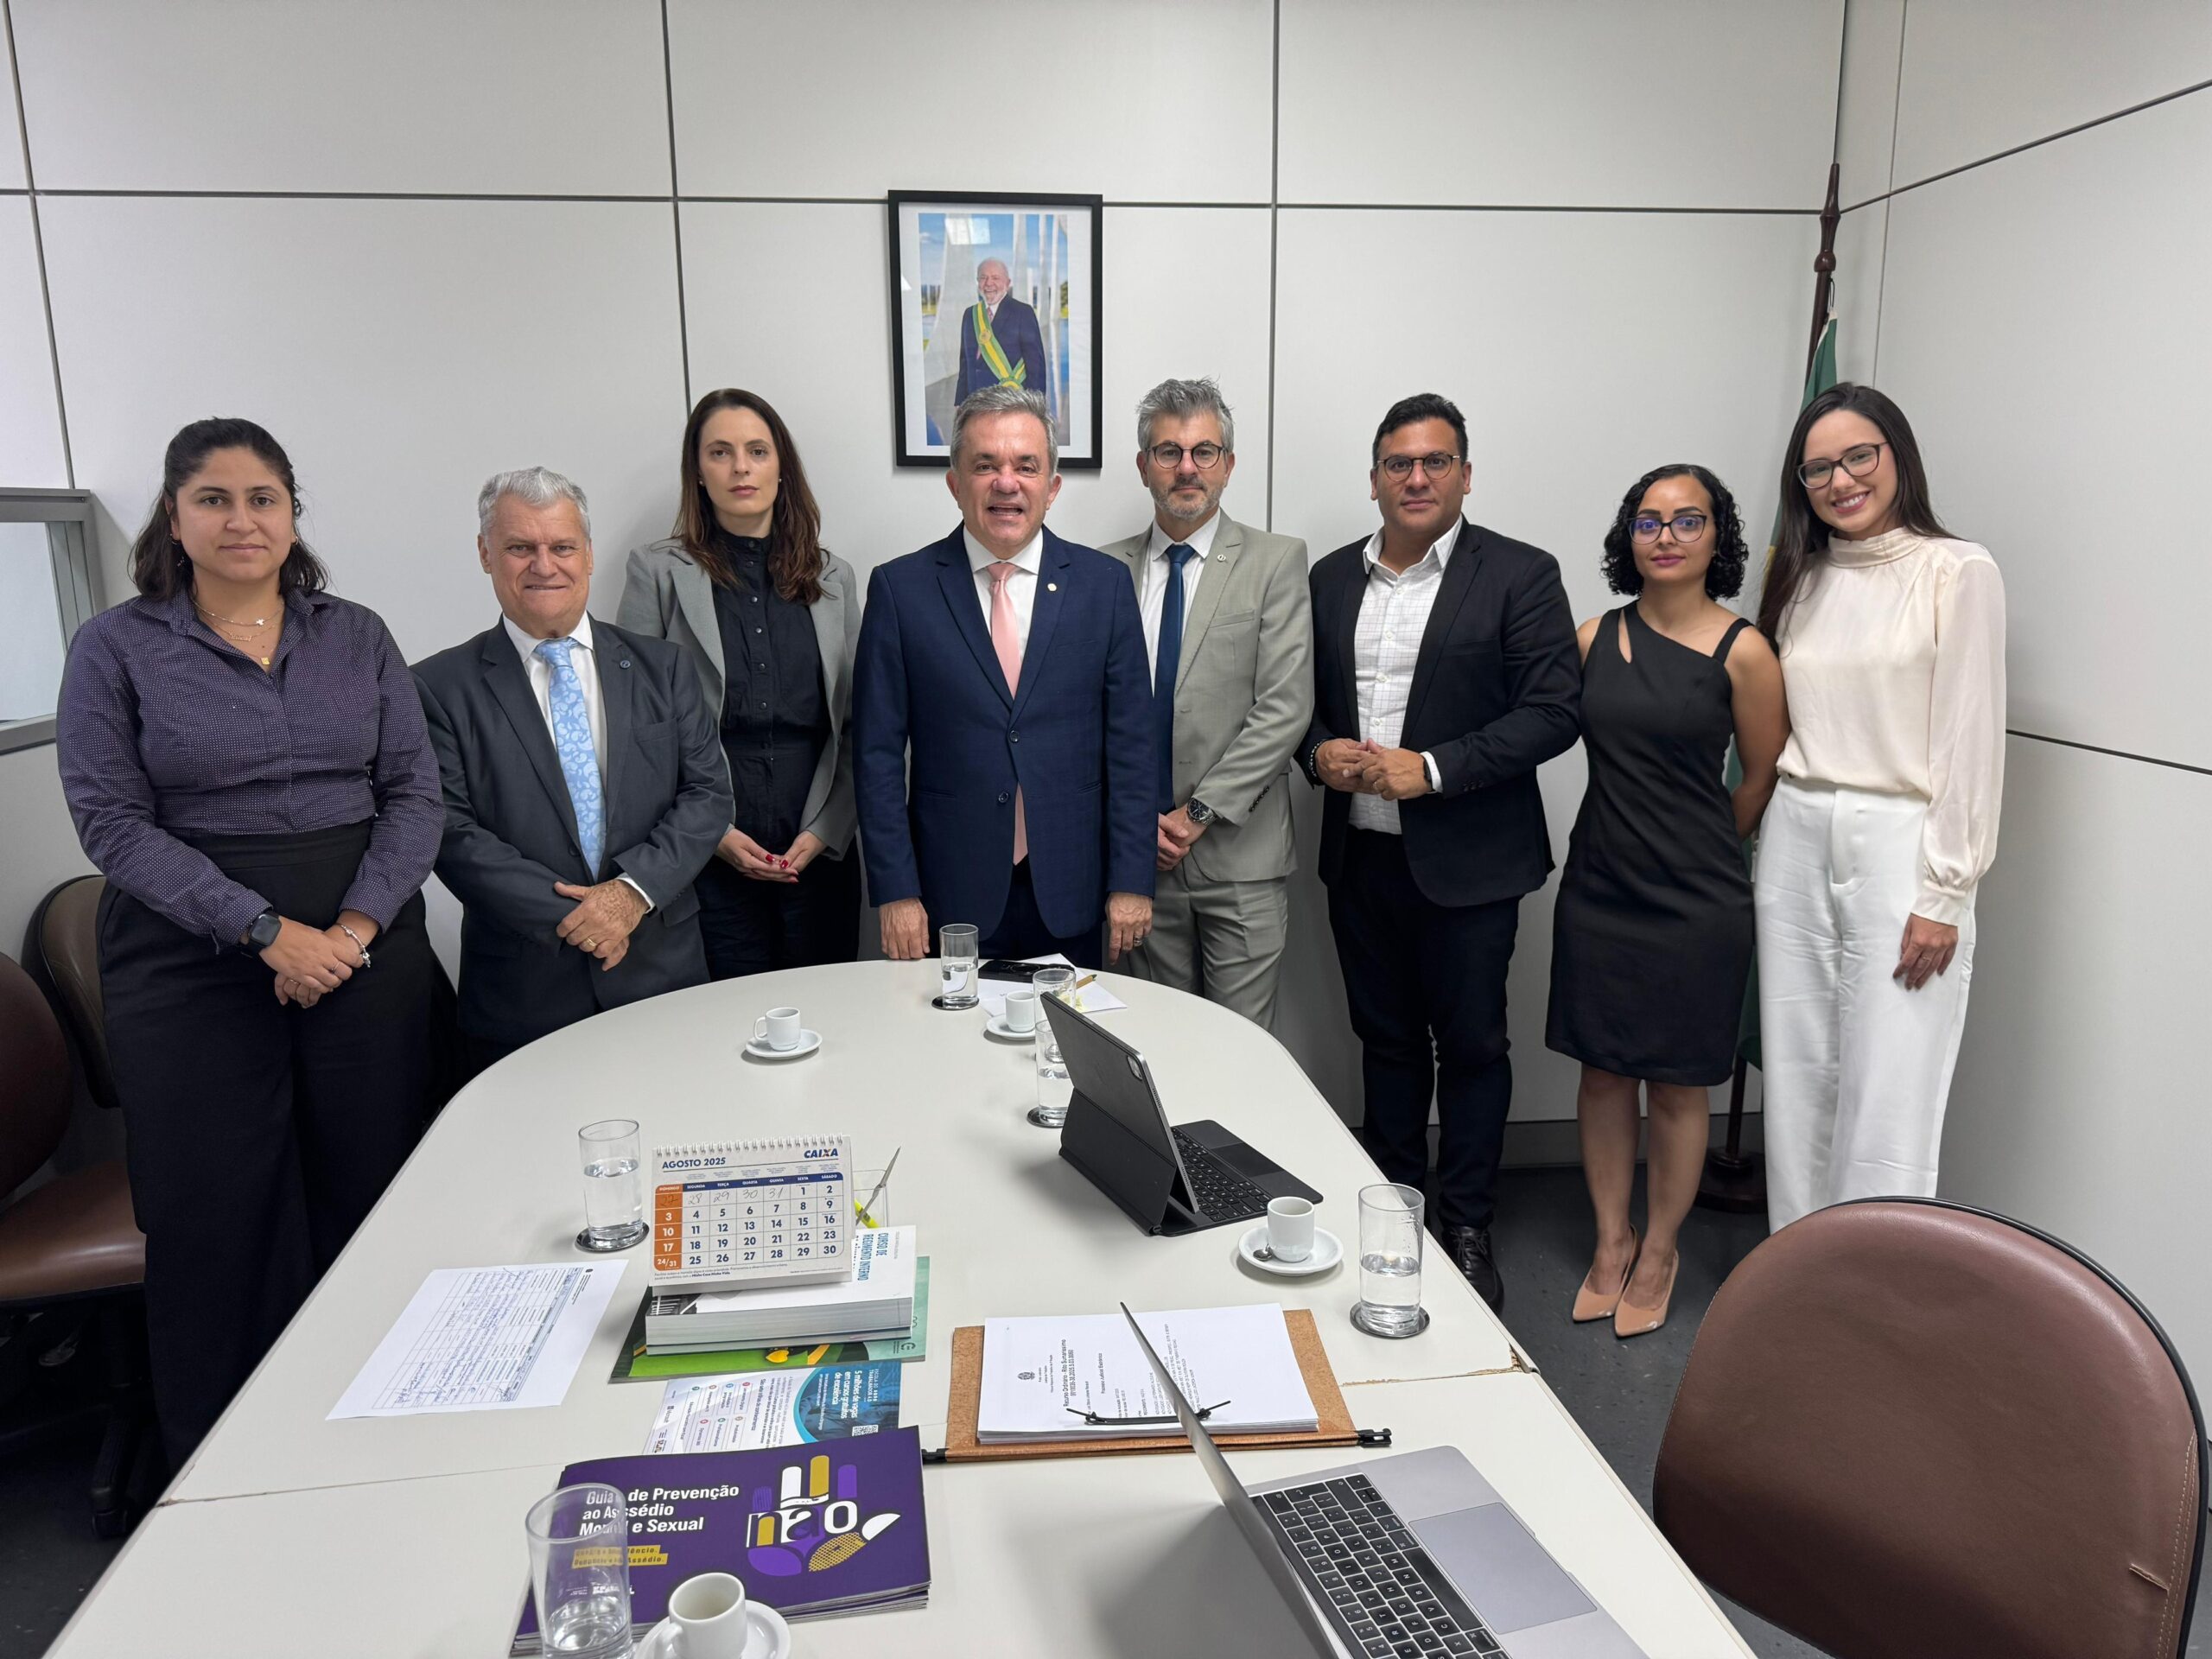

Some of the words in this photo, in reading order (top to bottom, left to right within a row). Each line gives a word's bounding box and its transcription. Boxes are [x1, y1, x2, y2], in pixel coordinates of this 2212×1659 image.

[804, 1148, 838, 1158] CAIXA
[662, 1159, 701, 1169] AGOSTO
[703, 1157, 726, 1166] 2025
[689, 1192, 702, 1205] 28
[713, 1191, 729, 1203] 29
[742, 1189, 758, 1198] 30
[769, 1186, 784, 1198] 31
[665, 1212, 672, 1221] 3
[662, 1228, 674, 1236] 10
[691, 1225, 700, 1234] 11
[717, 1224, 728, 1232] 12
[772, 1219, 782, 1228] 14
[663, 1243, 674, 1252] 17
[690, 1241, 701, 1249] 18
[772, 1235, 782, 1243] 21
[823, 1230, 836, 1239] 23
[861, 1234, 874, 1260] REGIMENTO
[877, 1233, 888, 1249] CURSO
[716, 1254, 729, 1262] 26
[771, 1249, 783, 1258] 28
[823, 1245, 836, 1254] 30
[857, 1261, 871, 1281] INTERNO
[844, 1371, 851, 1380] em
[832, 1379, 841, 1405] excelência
[853, 1375, 862, 1395] milhões
[841, 1396, 850, 1419] gratuitos
[849, 1402, 858, 1418] vagas
[586, 1491, 613, 1505] Guia
[628, 1489, 648, 1502] de
[652, 1484, 740, 1501] Prevenção
[582, 1509, 601, 1520] ao
[632, 1522, 643, 1533] e
[646, 1516, 704, 1533] Sexual
